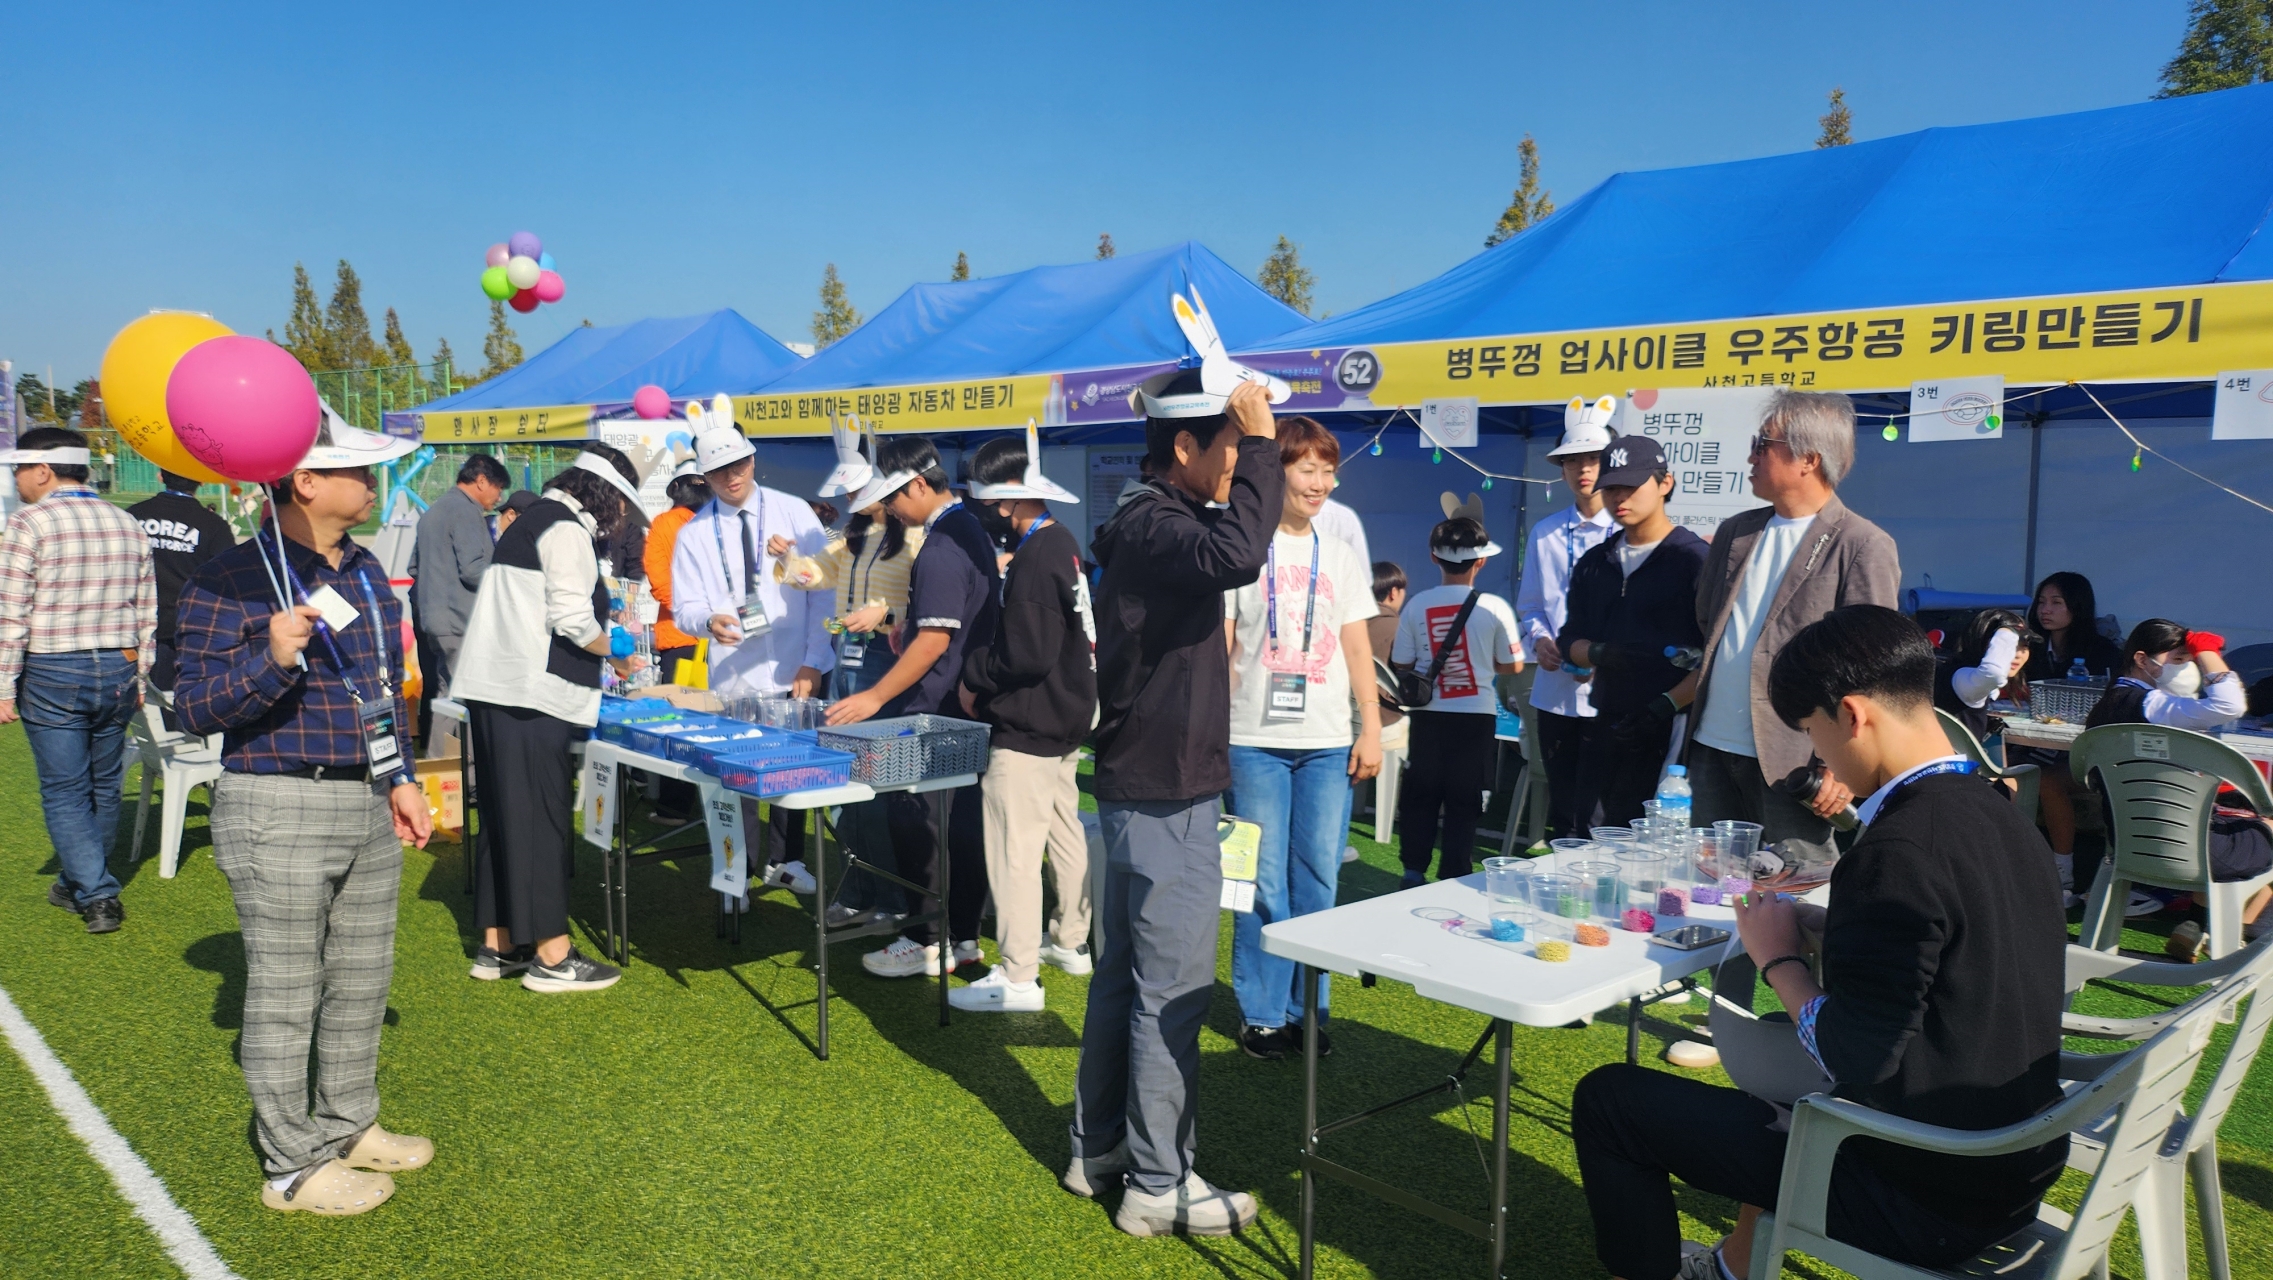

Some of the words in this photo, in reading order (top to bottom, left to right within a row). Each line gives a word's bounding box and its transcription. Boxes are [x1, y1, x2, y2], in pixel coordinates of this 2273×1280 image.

[1447, 343, 1542, 380] 병뚜껑
[1560, 332, 1707, 375] 업사이클
[1728, 318, 1905, 366] 우주항공
[1930, 298, 2203, 354] 키링만들기
[1342, 358, 1373, 385] 52
[1703, 371, 1815, 388] 사천고등학교
[1917, 386, 1938, 399] 3번
[2224, 377, 2251, 392] 4번
[744, 399, 793, 421] 사천고와
[798, 396, 851, 420] 함께하는
[858, 392, 901, 415] 태양광
[908, 388, 956, 413] 자동차
[963, 383, 1014, 410] 만들기
[1425, 404, 1437, 415] 1번
[1643, 412, 1703, 436] 병뚜껑
[604, 433, 639, 447] 태양광
[1609, 448, 1628, 468] NY
[1663, 442, 1720, 465] 사이클
[1682, 471, 1744, 494] 만들기
[161, 538, 195, 553] FORCE
[1277, 695, 1299, 703] STAFF
